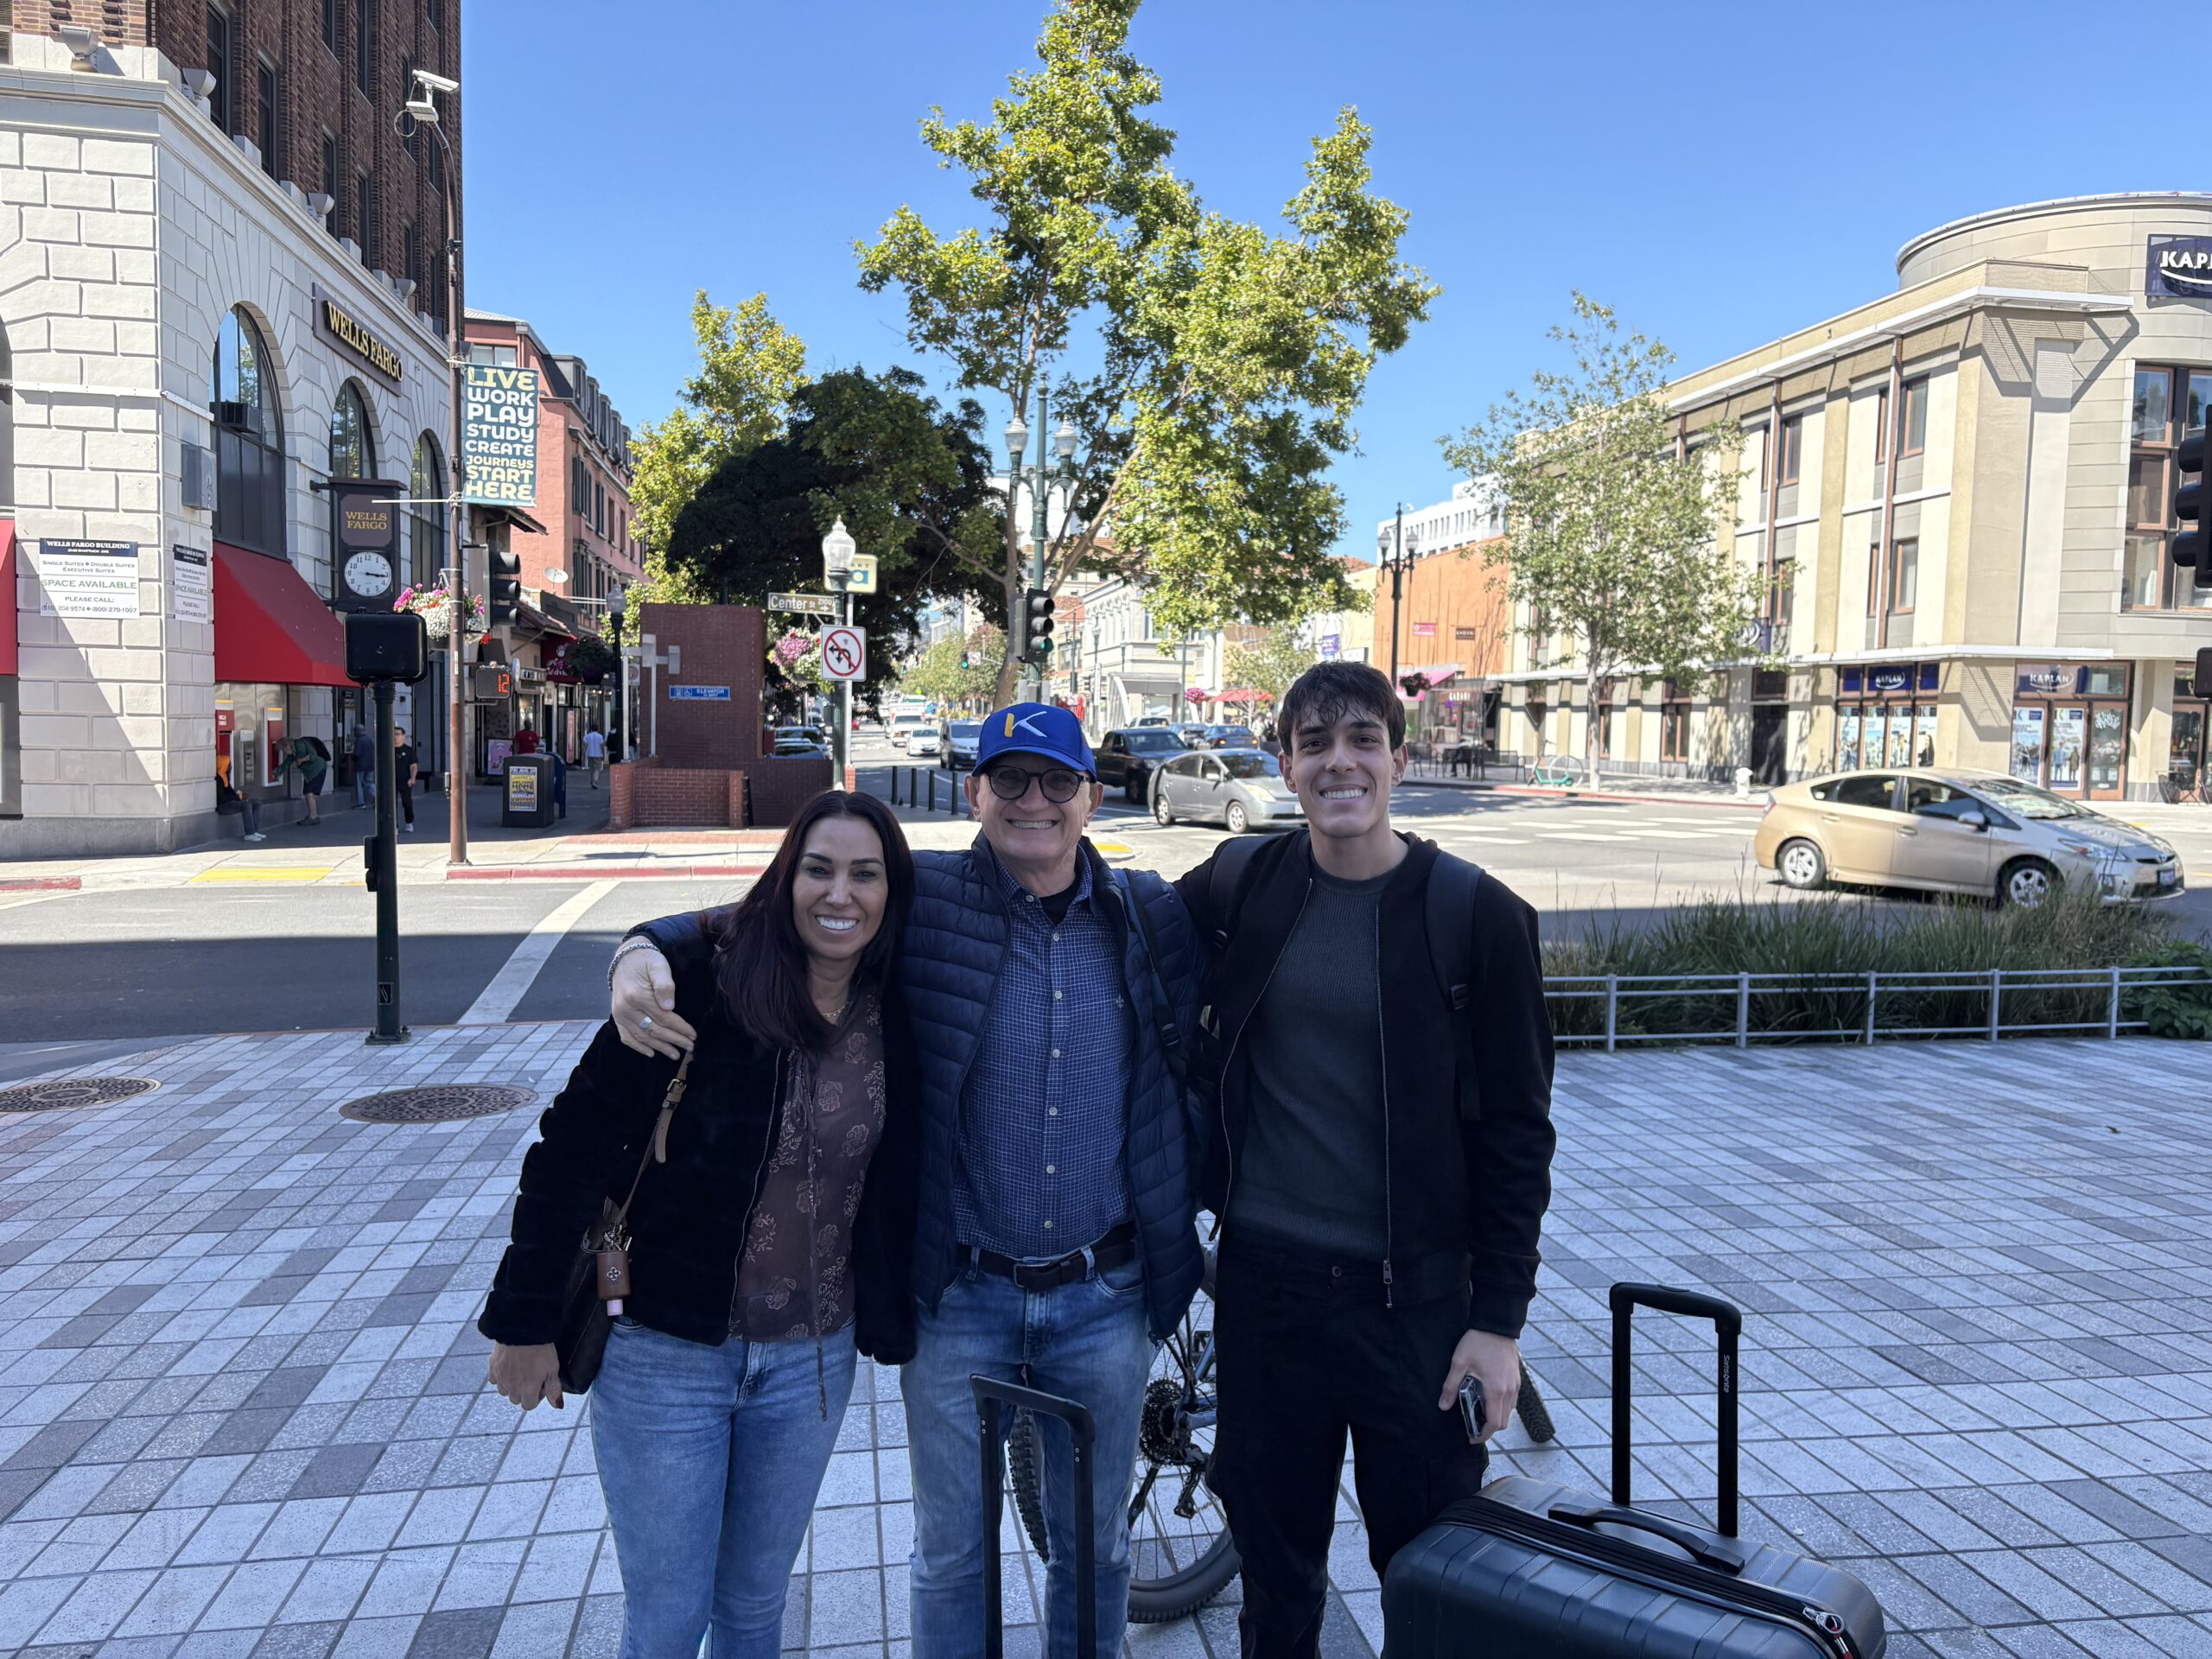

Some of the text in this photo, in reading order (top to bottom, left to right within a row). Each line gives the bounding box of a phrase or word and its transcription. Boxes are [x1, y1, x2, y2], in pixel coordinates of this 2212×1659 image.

[2160, 251, 2212, 270] KAP
[327, 301, 404, 382] WELLS FARGO
[467, 366, 535, 391] LIVE
[467, 387, 535, 407] WORK
[467, 403, 535, 428] PLAY
[467, 423, 535, 443] STUDY
[465, 439, 535, 457] CREATE
[466, 455, 534, 469] JOURNEYS
[466, 465, 534, 484] START
[465, 480, 533, 501] HERE
[346, 512, 387, 521] WELLS
[347, 520, 387, 531] FARGO
[41, 579, 137, 589] SPACE AVAILABLE
[771, 595, 807, 610] Center
[497, 673, 511, 694] 12
[2030, 673, 2069, 683] KAPLAN
